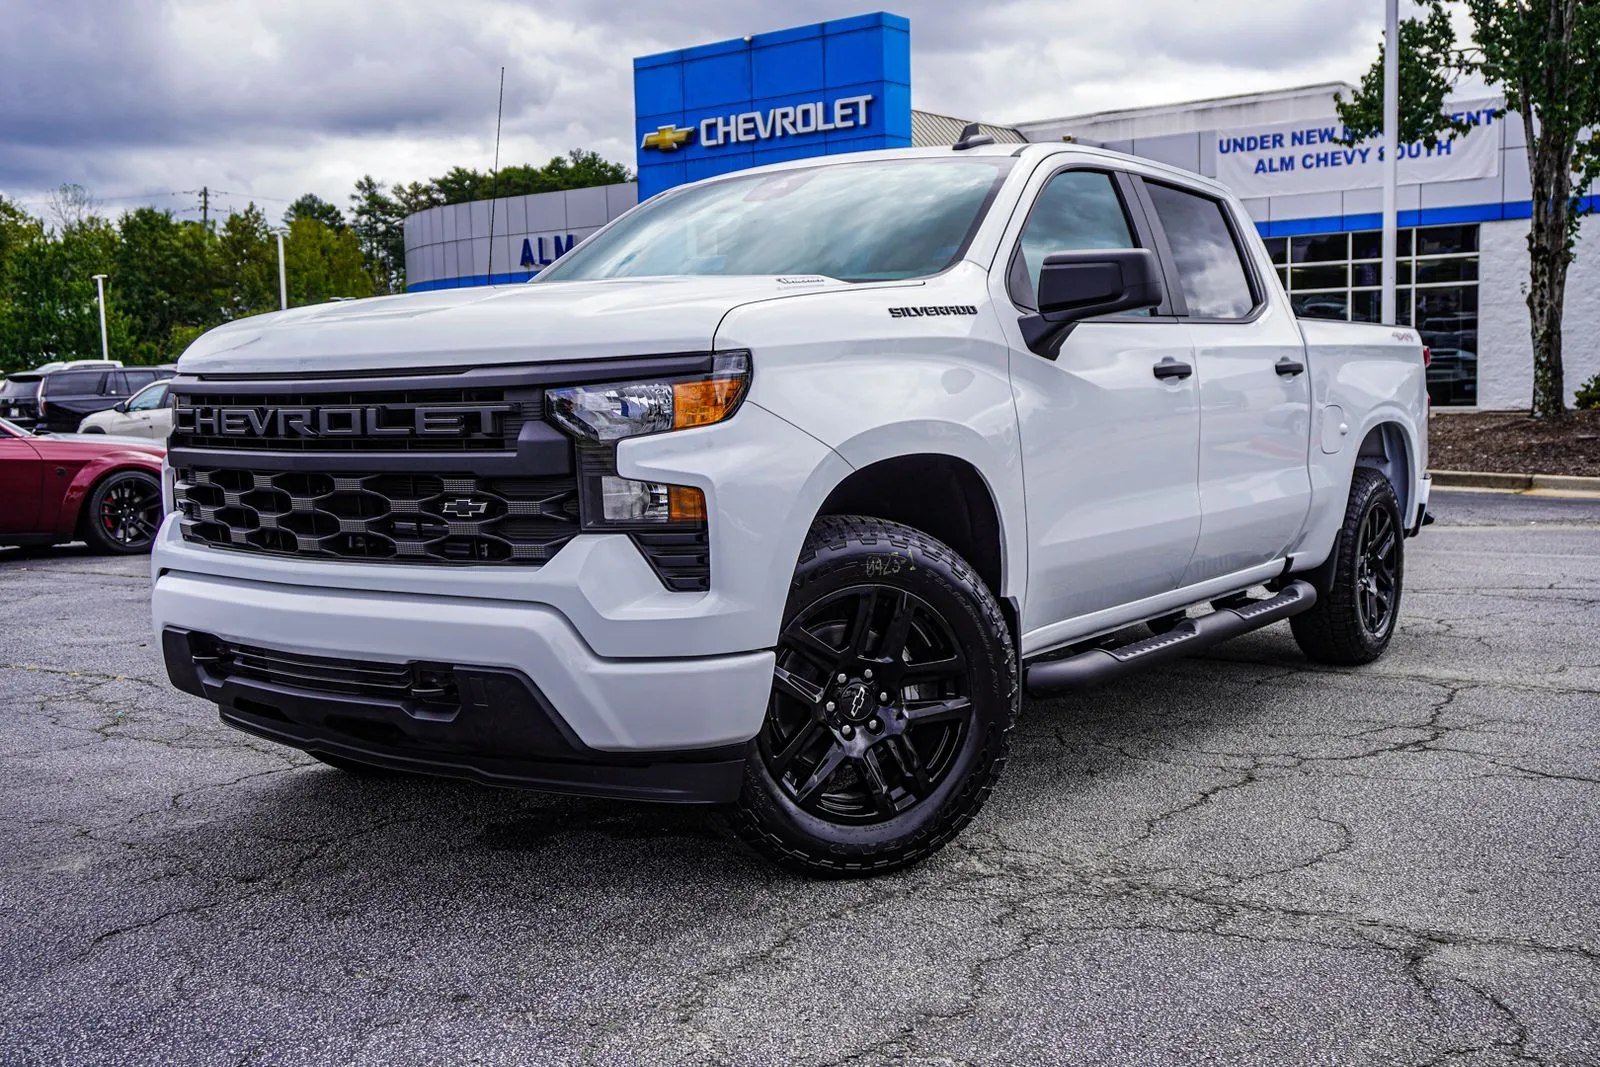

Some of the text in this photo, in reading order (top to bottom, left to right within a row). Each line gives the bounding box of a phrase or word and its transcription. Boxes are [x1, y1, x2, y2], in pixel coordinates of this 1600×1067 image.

[700, 94, 873, 147] CHEVROLET
[1218, 127, 1336, 154] UNDER NEW
[1254, 155, 1295, 174] ALM
[1302, 147, 1371, 170] CHEVY
[519, 234, 574, 267] ALM
[888, 304, 978, 318] SILVERADO
[174, 402, 518, 438] CHEVROLET
